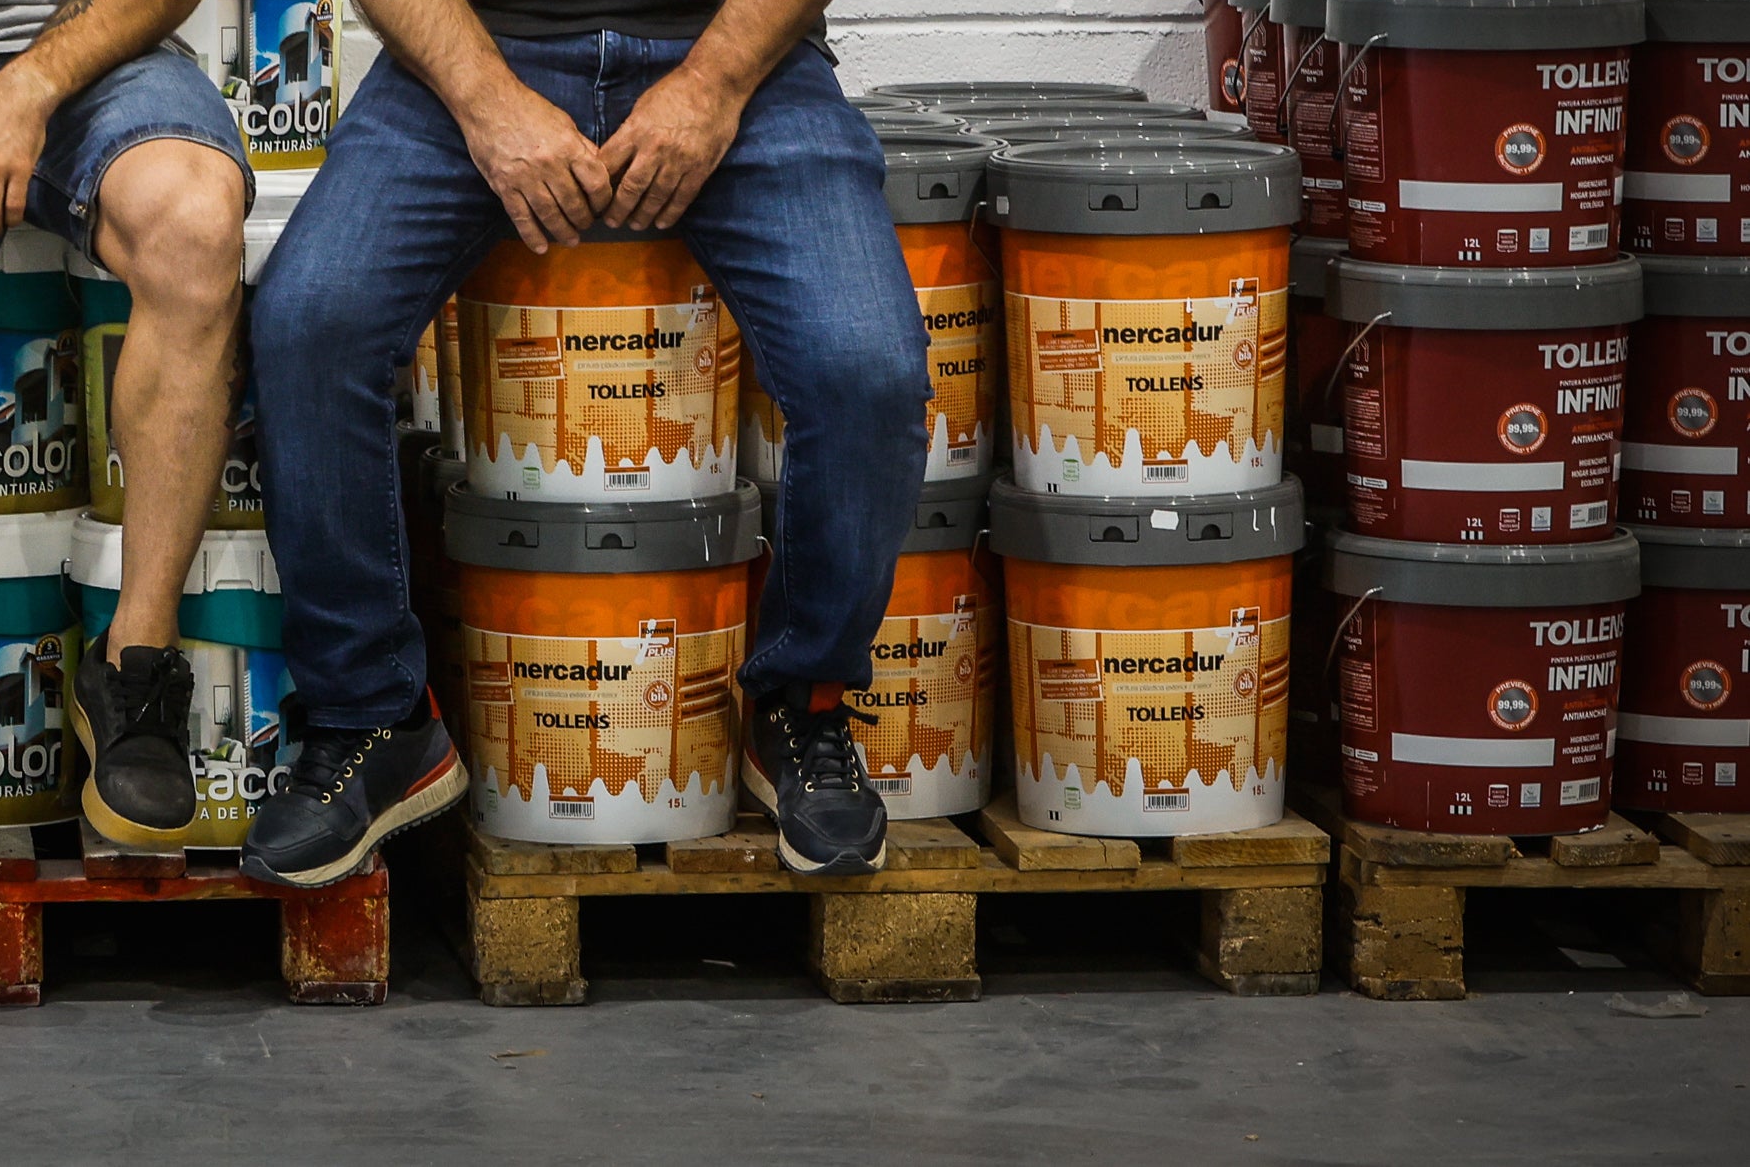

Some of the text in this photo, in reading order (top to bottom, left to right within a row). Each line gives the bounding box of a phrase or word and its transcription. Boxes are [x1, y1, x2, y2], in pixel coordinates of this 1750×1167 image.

[1536, 59, 1630, 90] TOLLENS
[235, 91, 330, 136] color
[1503, 124, 1540, 138] PREVIENE
[250, 139, 312, 154] PINTURAS
[1464, 238, 1480, 247] 12L
[565, 328, 685, 351] nercadur
[1104, 322, 1223, 344] nercadur
[937, 358, 986, 376] TOLLENS
[588, 383, 665, 399] TOLLENS
[1126, 376, 1203, 392] TOLLENS
[1505, 404, 1542, 417] PREVIENE
[1466, 518, 1482, 527] 12L
[1530, 613, 1625, 646] TOLLENS
[649, 647, 674, 656] PLUS
[870, 638, 947, 659] rcadur
[1104, 652, 1224, 674] nercadur
[1551, 656, 1573, 664] PINTURA
[514, 660, 632, 680] nercadur
[1496, 681, 1532, 694] PREVIENE
[853, 691, 927, 706] TOLLENS
[534, 713, 610, 729] TOLLENS
[1127, 706, 1204, 722] TOLLENS
[1562, 746, 1580, 755] HOGAR
[1455, 792, 1471, 802] 12L
[218, 807, 238, 819] DE
